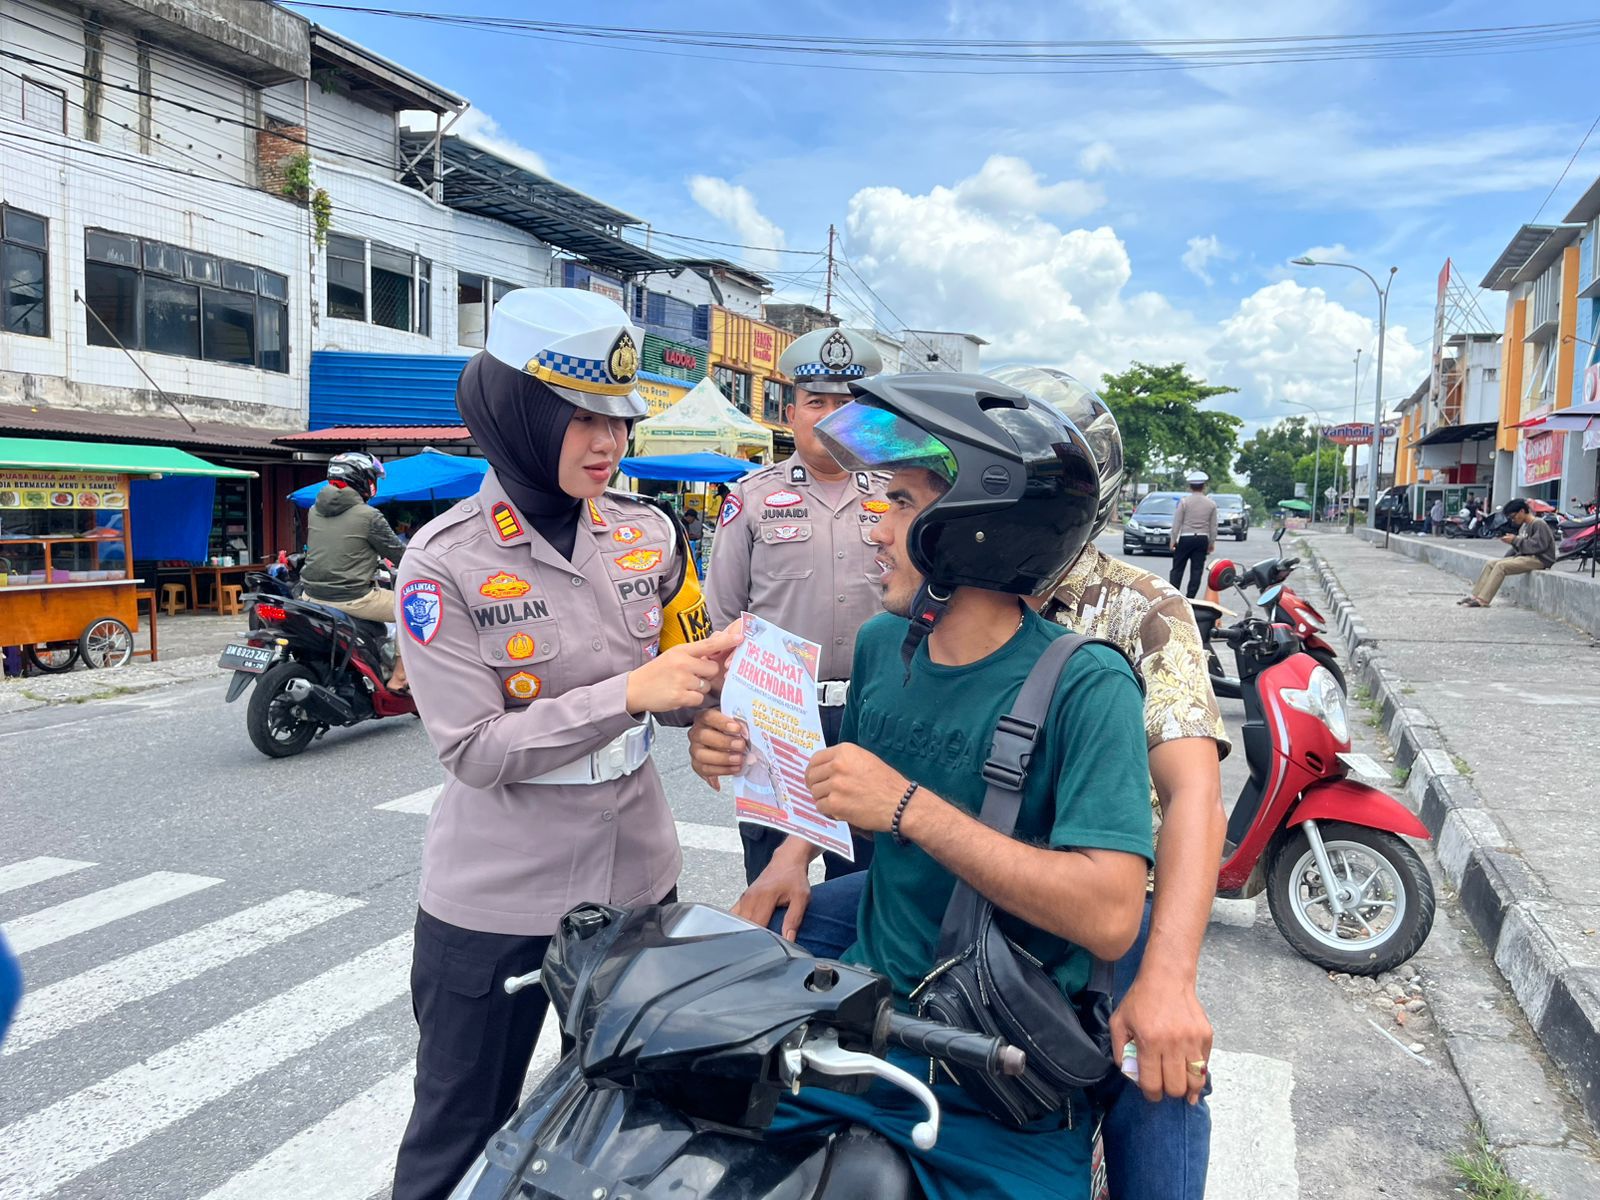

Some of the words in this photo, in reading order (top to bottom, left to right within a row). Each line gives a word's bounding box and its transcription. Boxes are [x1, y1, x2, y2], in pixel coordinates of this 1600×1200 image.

[665, 350, 697, 369] LADORA
[761, 508, 809, 520] JUNAIDI
[859, 513, 882, 523] PO
[415, 582, 436, 592] LINTAS
[474, 600, 550, 627] WULAN
[760, 650, 804, 685] SELAMAT
[737, 658, 804, 707] BERKENDARA
